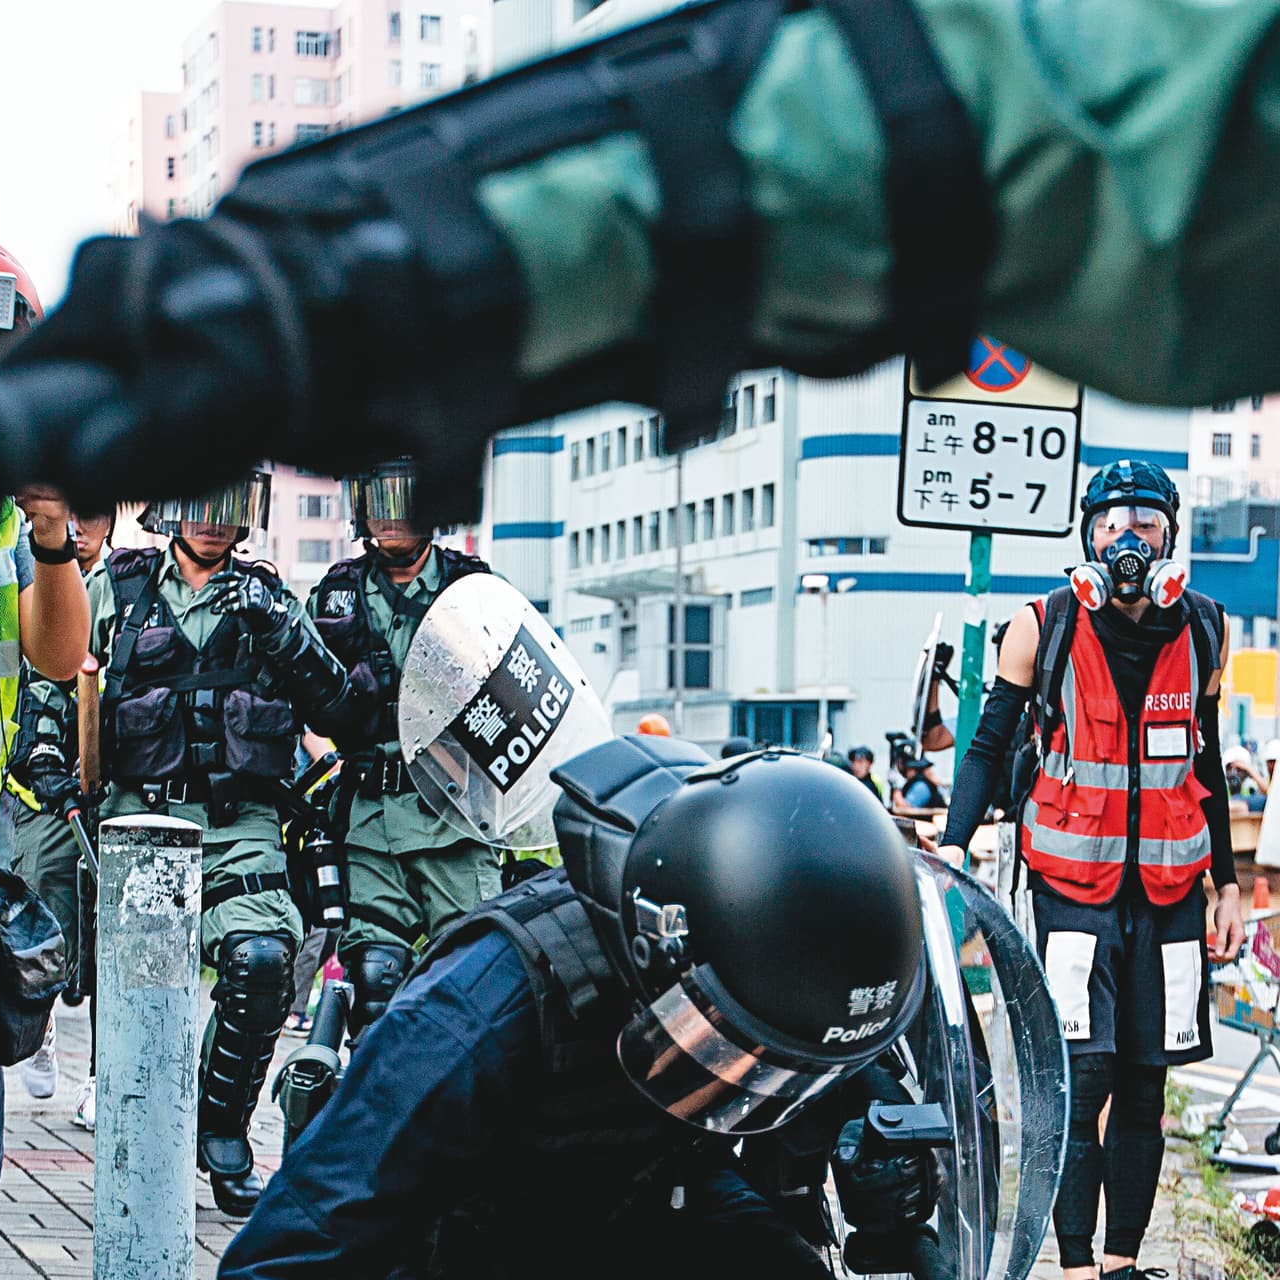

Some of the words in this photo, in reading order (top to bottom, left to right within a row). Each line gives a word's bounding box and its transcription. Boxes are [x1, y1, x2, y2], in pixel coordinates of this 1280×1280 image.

[927, 413, 956, 426] am
[916, 432, 964, 456] 上午
[972, 421, 1066, 460] 8-10
[922, 470, 953, 485] pm
[914, 489, 960, 512] 下午
[463, 643, 542, 747] 警察
[1144, 691, 1191, 712] RESCUE
[488, 675, 569, 786] POLICE
[847, 980, 898, 1016] 警察
[821, 1016, 891, 1044] Police
